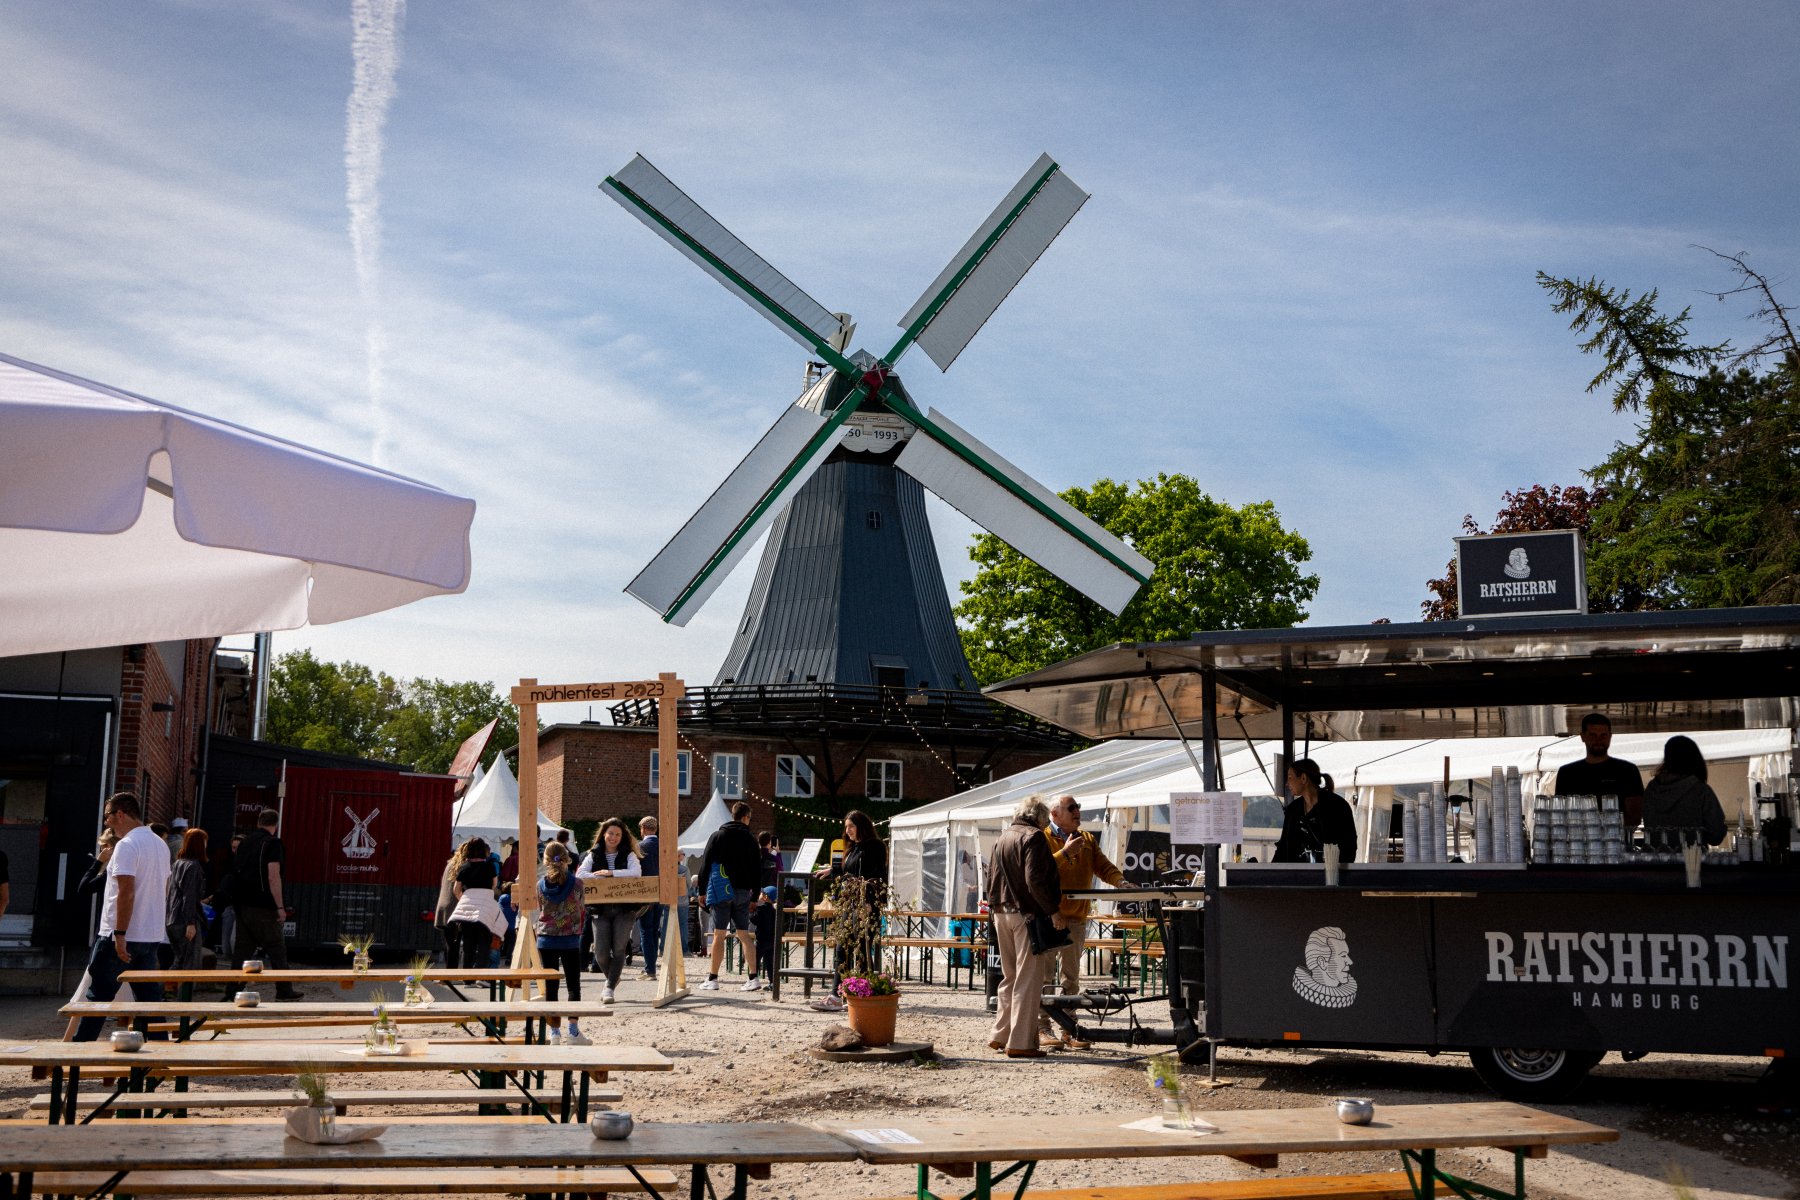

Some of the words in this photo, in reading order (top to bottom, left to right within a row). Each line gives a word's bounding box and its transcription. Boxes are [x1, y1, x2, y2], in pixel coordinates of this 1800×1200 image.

[845, 429, 861, 438] 50
[873, 430, 898, 441] 1993
[1480, 580, 1557, 598] RATSHERRN
[530, 685, 616, 701] mühlenfest
[624, 683, 665, 698] 2023
[1484, 931, 1789, 989] RATSHERRN
[1572, 991, 1700, 1010] HAMBURG
